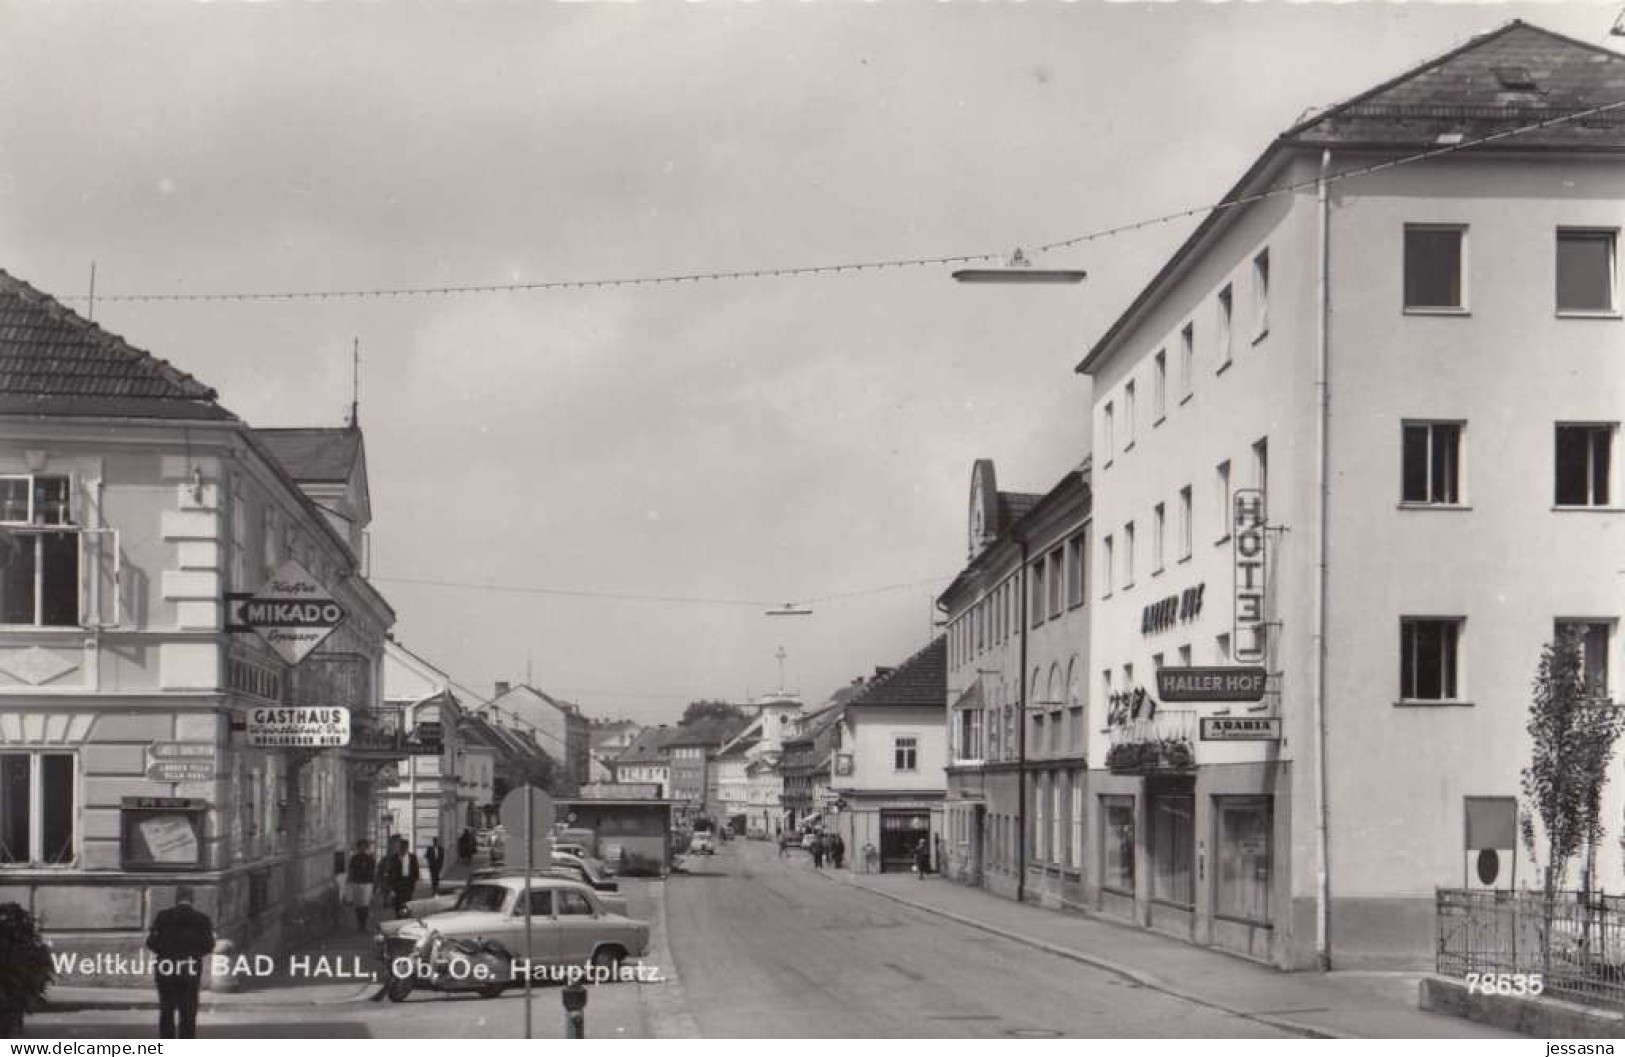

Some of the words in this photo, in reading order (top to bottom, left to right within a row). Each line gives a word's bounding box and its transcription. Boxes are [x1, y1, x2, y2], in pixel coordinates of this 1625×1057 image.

[248, 604, 339, 622] MIKADO
[1163, 676, 1221, 691] HALLER
[1226, 676, 1262, 691] HOF
[254, 709, 341, 723] GASTHAUS
[1211, 721, 1271, 730] ARABIA
